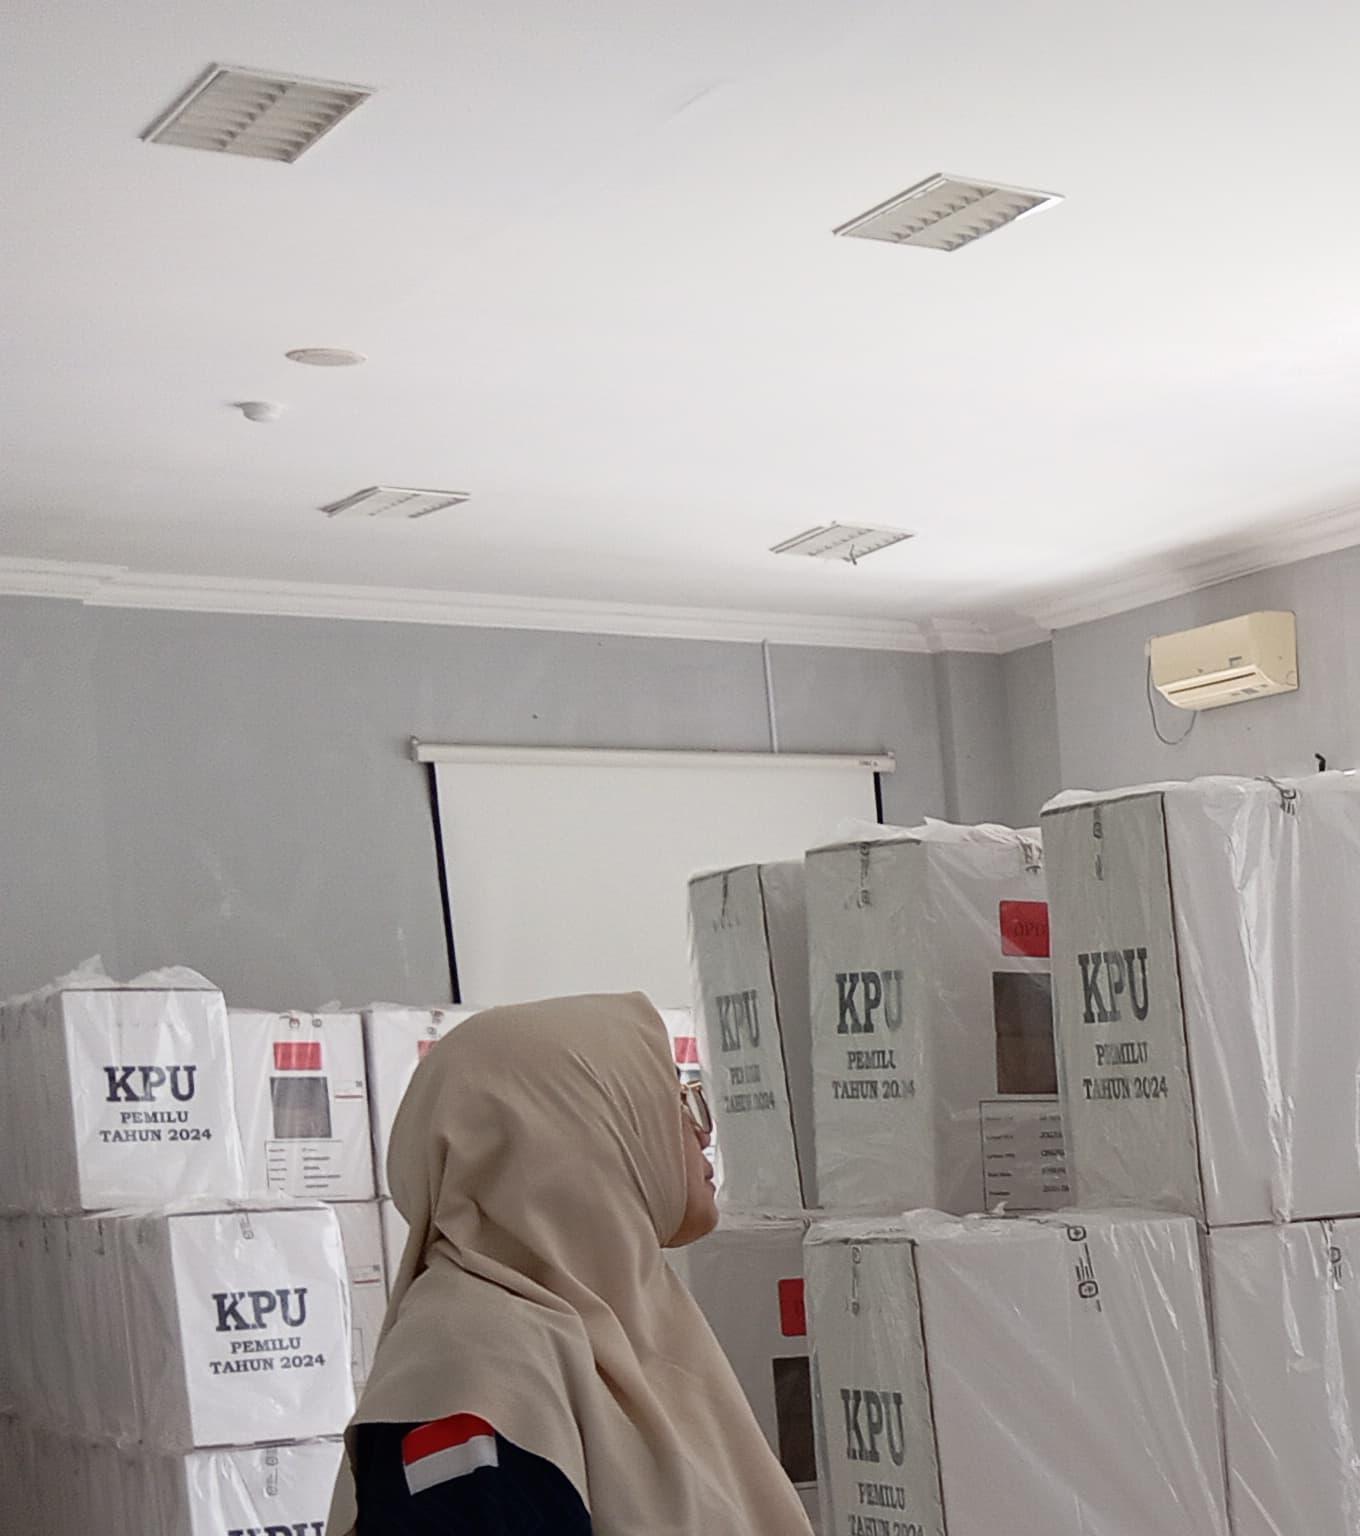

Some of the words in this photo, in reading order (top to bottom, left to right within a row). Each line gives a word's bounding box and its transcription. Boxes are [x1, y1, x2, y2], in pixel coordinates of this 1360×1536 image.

[1078, 948, 1149, 1023] KPU
[836, 970, 904, 1034] KPU
[716, 990, 759, 1052] KPU
[105, 1065, 196, 1102] KPU
[832, 1080, 878, 1099] TAHUN
[1083, 1078, 1130, 1099] TAHUN
[1134, 1075, 1168, 1098] 2024
[120, 1110, 188, 1125] PEMILU
[100, 1128, 163, 1143] TAHUN
[169, 1127, 212, 1141] 2024
[213, 1287, 308, 1332] KPU
[230, 1336, 301, 1354] PEMILU
[209, 1357, 274, 1375] TAHUN
[280, 1353, 325, 1369] 2024
[840, 1389, 904, 1466] KPU
